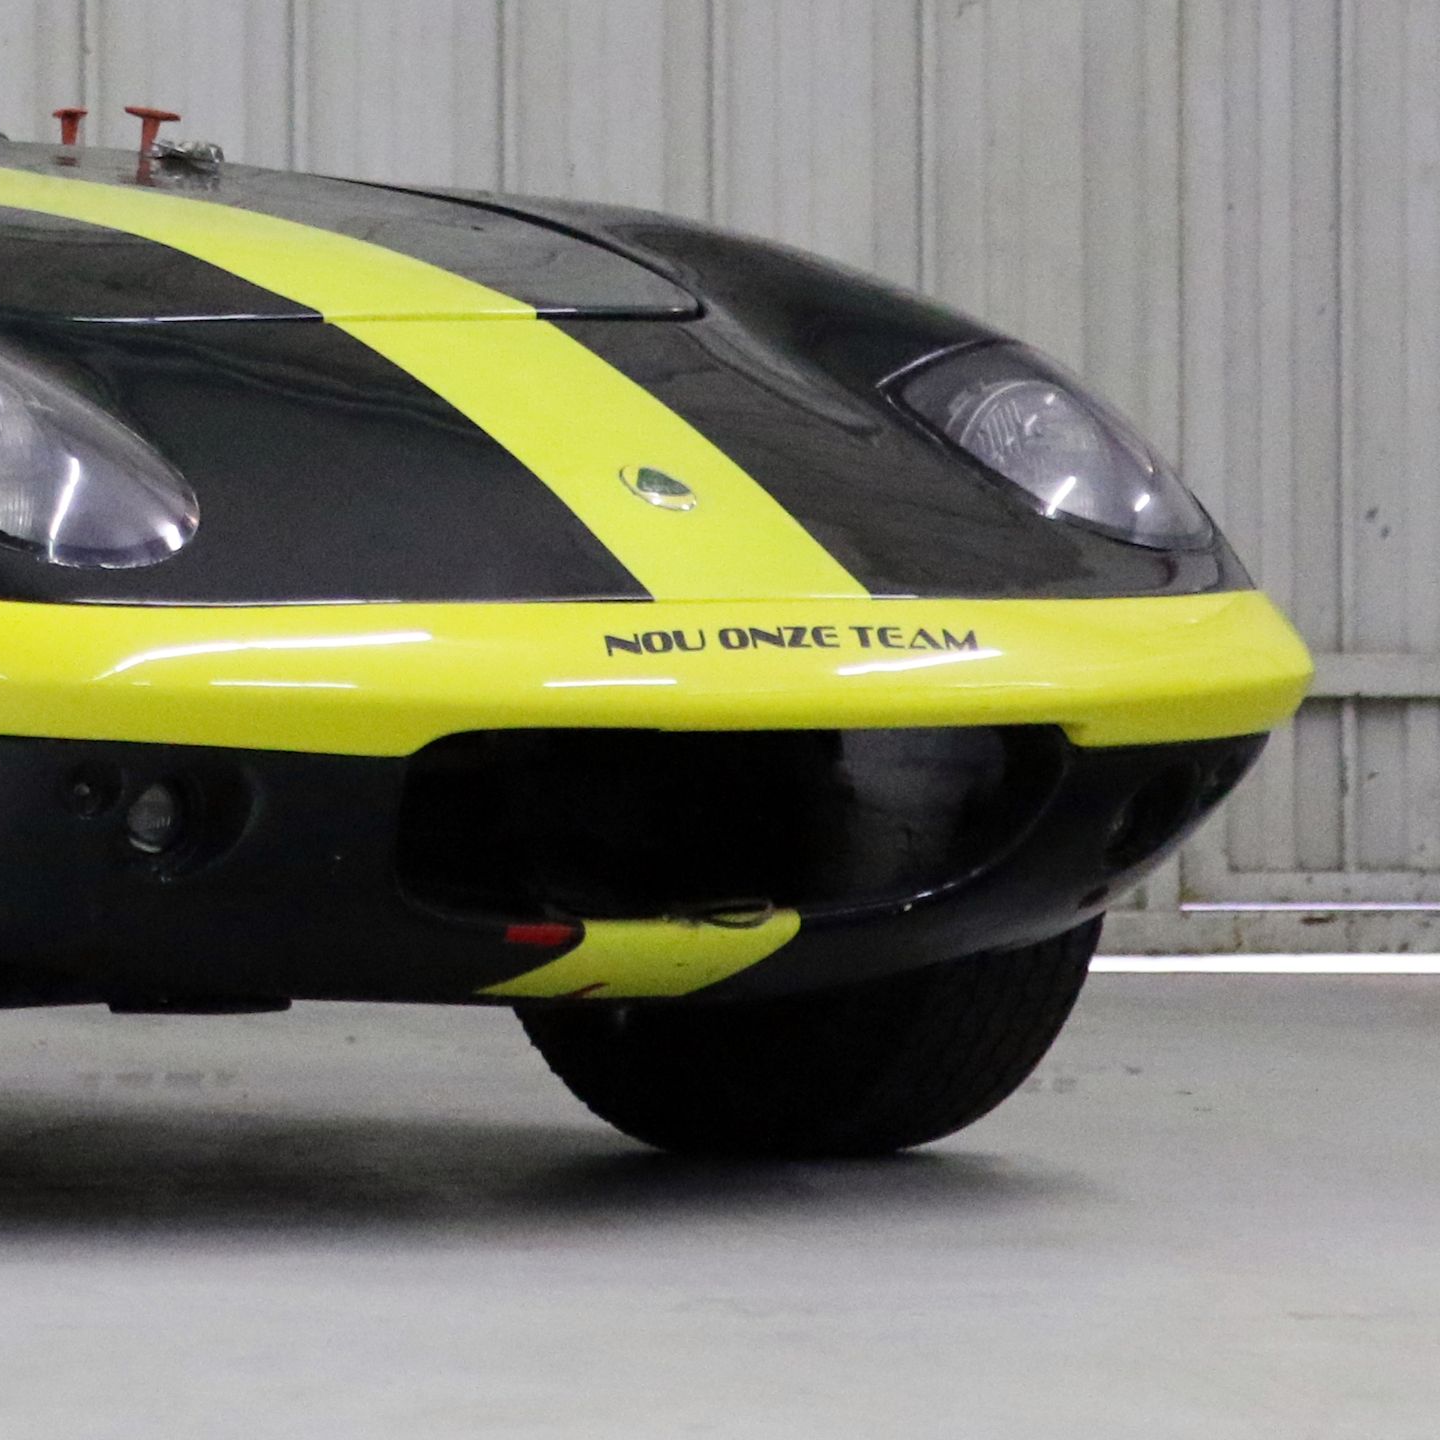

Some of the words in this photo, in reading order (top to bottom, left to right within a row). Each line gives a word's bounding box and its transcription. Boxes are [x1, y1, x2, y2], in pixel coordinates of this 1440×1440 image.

[604, 629, 706, 656] NOU
[719, 626, 840, 650] ONZE
[848, 626, 979, 652] TEAM
